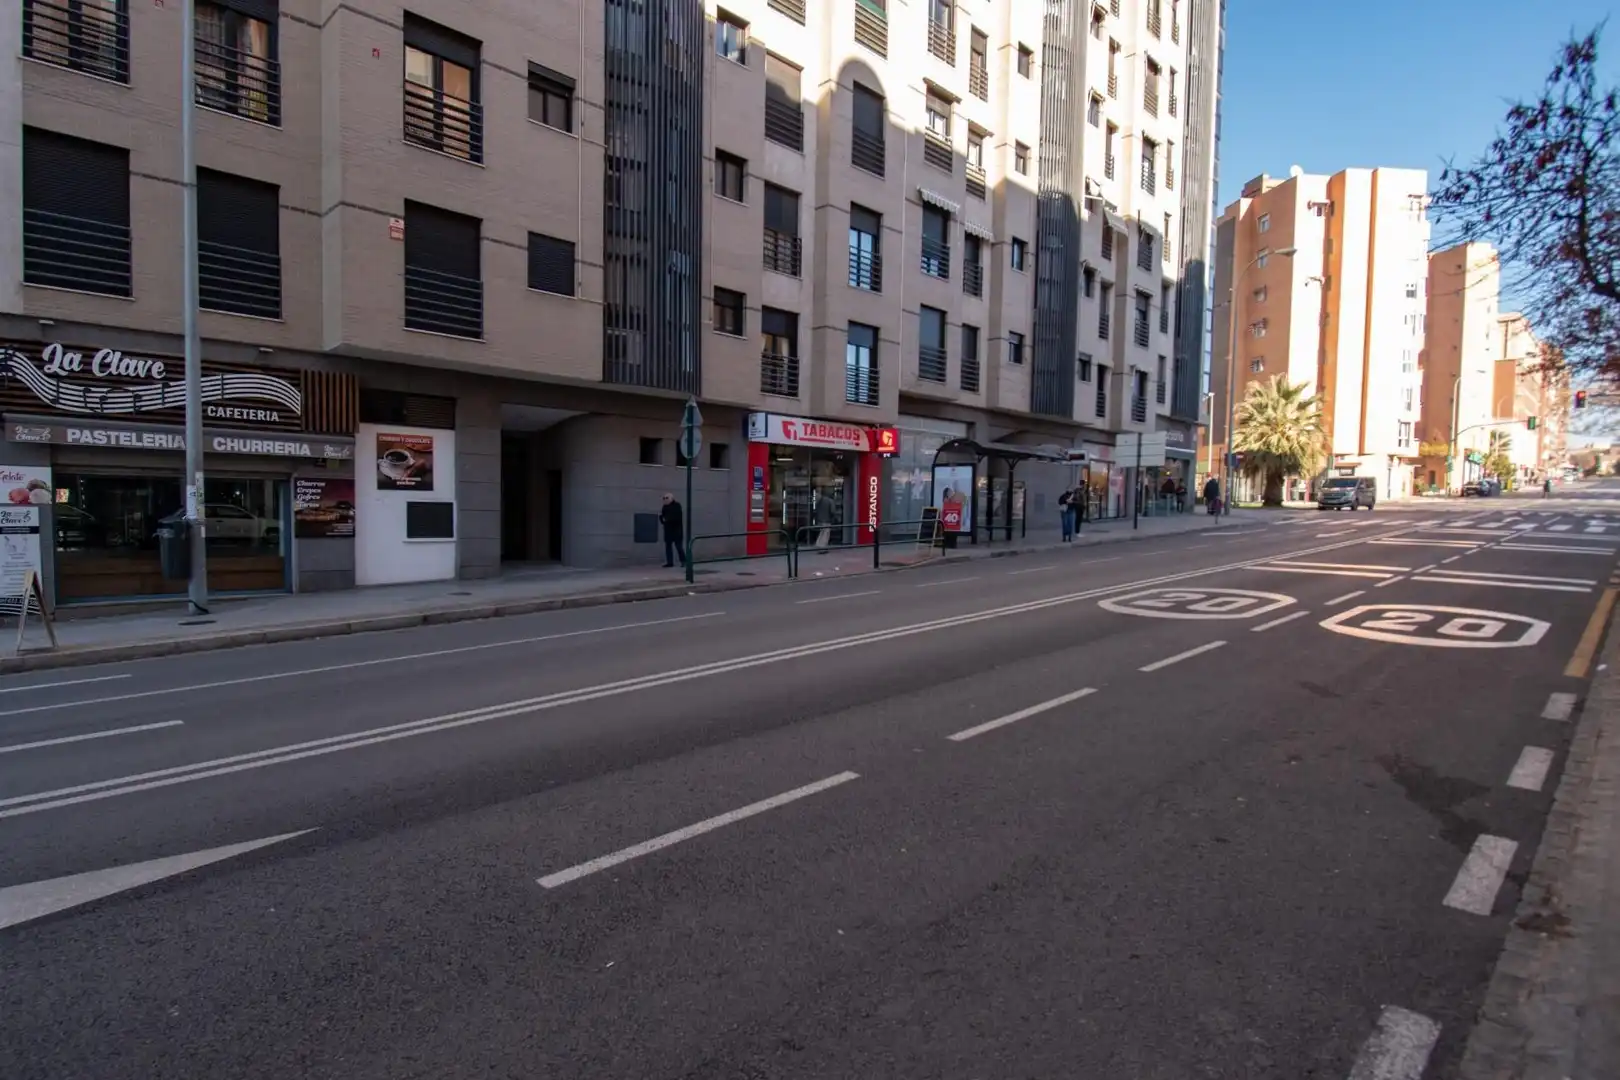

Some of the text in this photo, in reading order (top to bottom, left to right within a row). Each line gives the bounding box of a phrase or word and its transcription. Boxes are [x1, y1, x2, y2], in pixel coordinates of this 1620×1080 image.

[42, 343, 166, 379] La Clave
[207, 405, 280, 422] CAFETERIA
[66, 428, 187, 450] PASTELERIA
[802, 422, 861, 441] TABACOS
[212, 436, 311, 457] CHURRERIA
[868, 476, 878, 533] ESTANCO
[1360, 612, 1506, 638] 20
